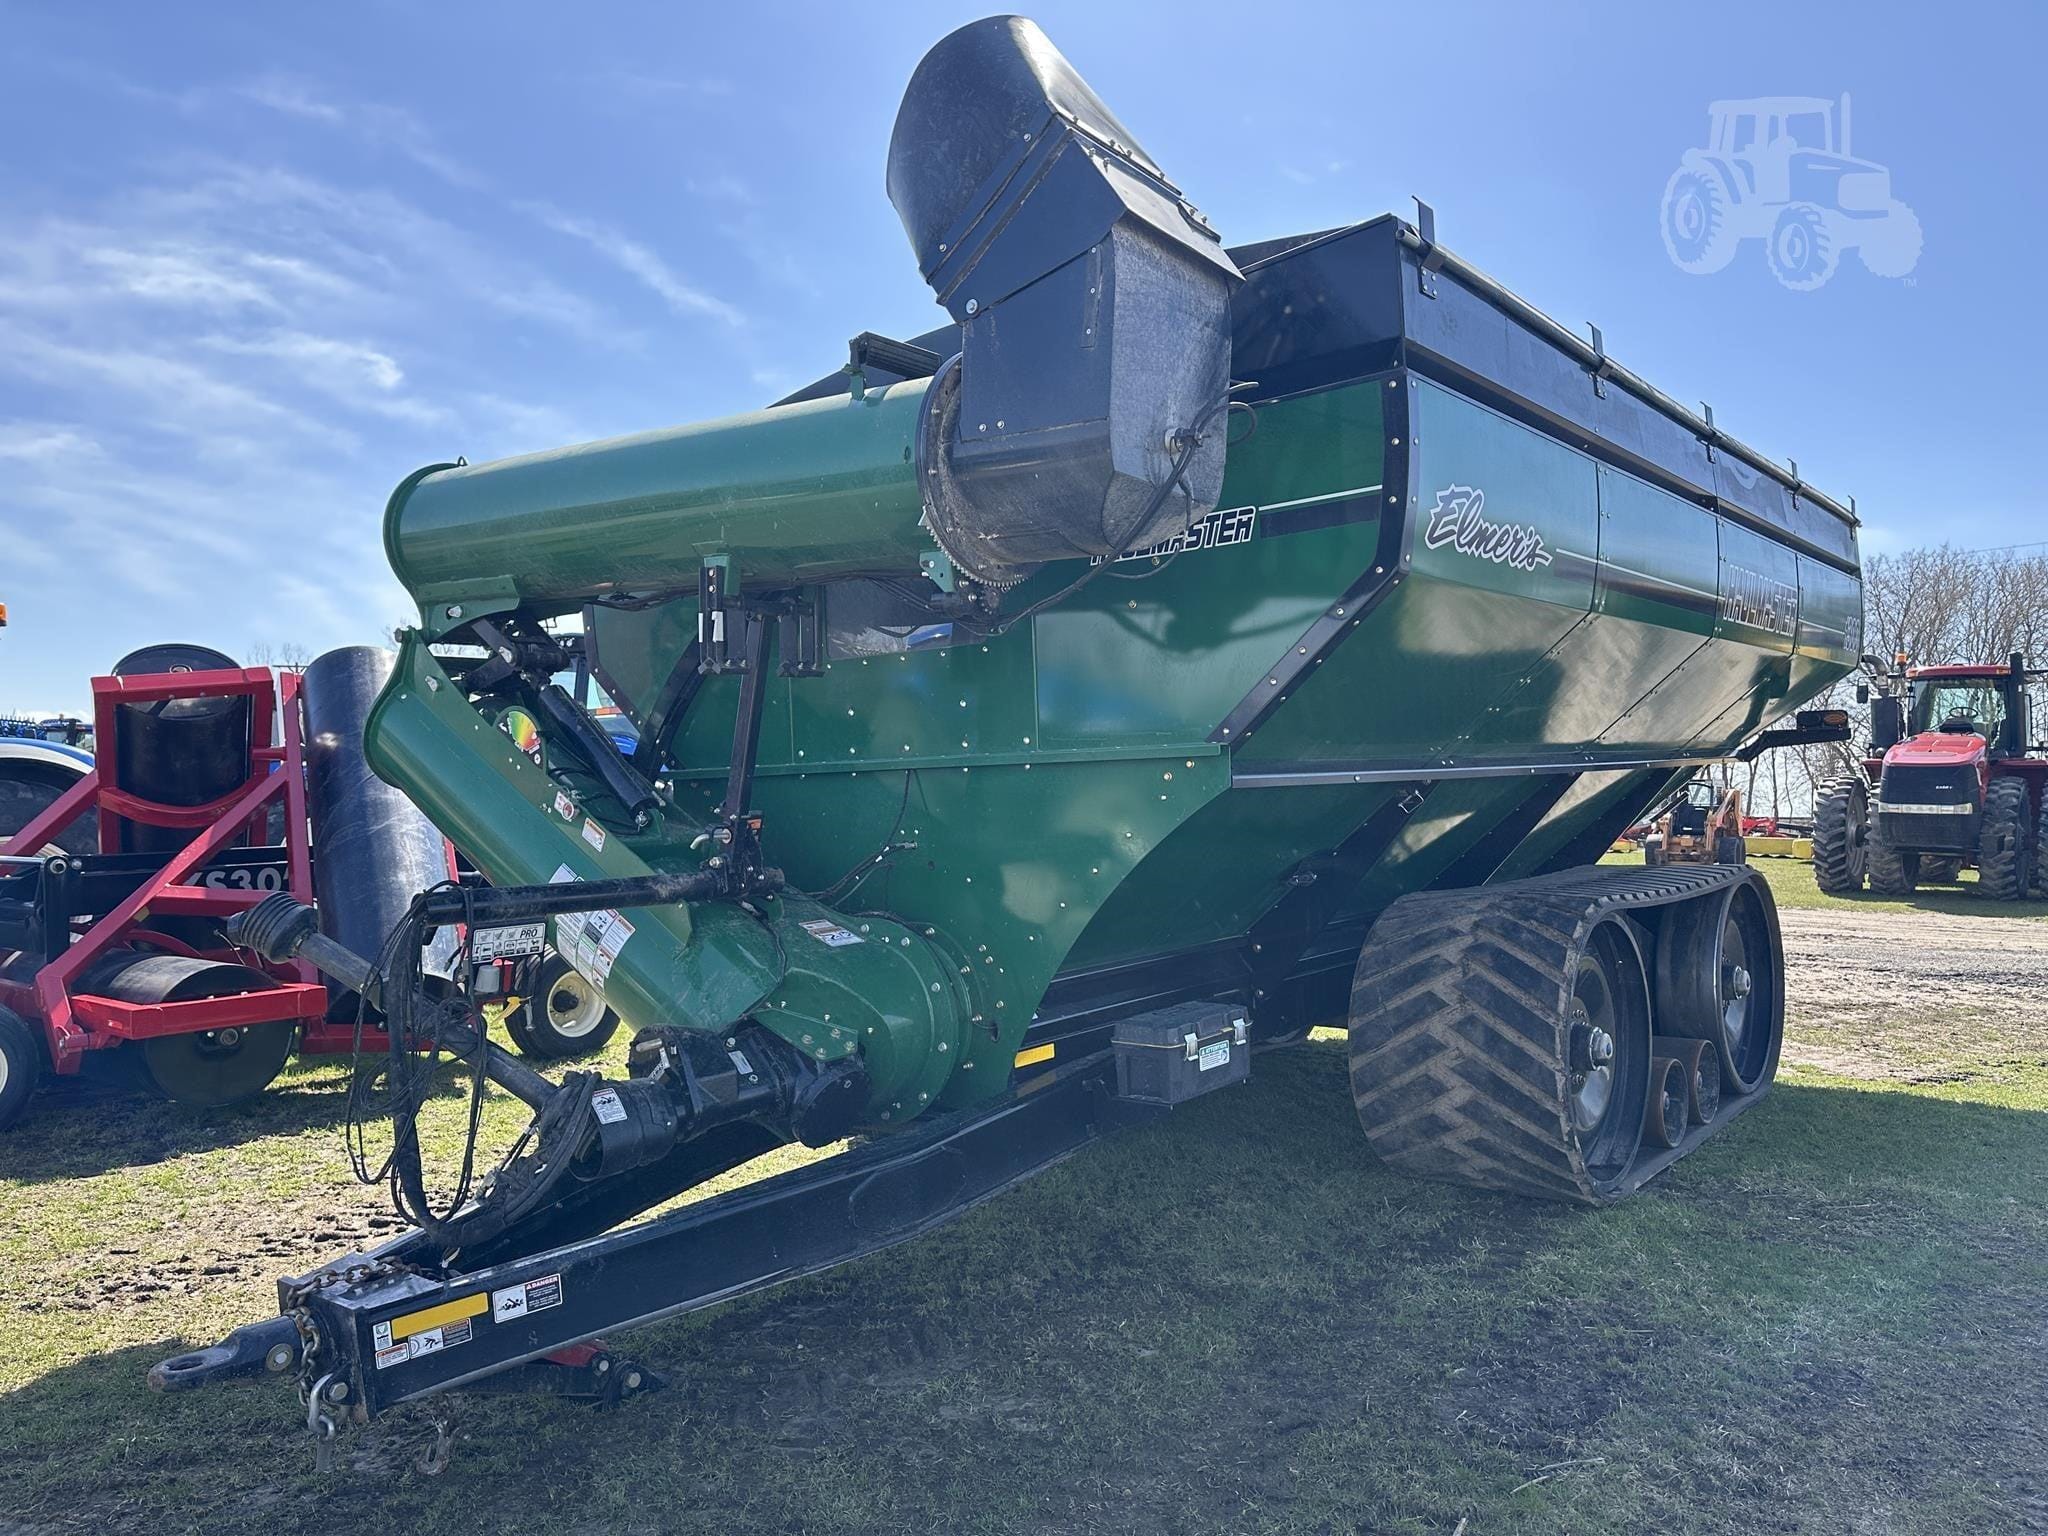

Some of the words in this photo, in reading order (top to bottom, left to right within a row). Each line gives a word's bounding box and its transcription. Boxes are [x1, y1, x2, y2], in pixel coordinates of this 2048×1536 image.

[1424, 483, 1553, 571] Elmer's
[520, 928, 538, 938] PRO
[532, 1276, 558, 1289] DANGER
